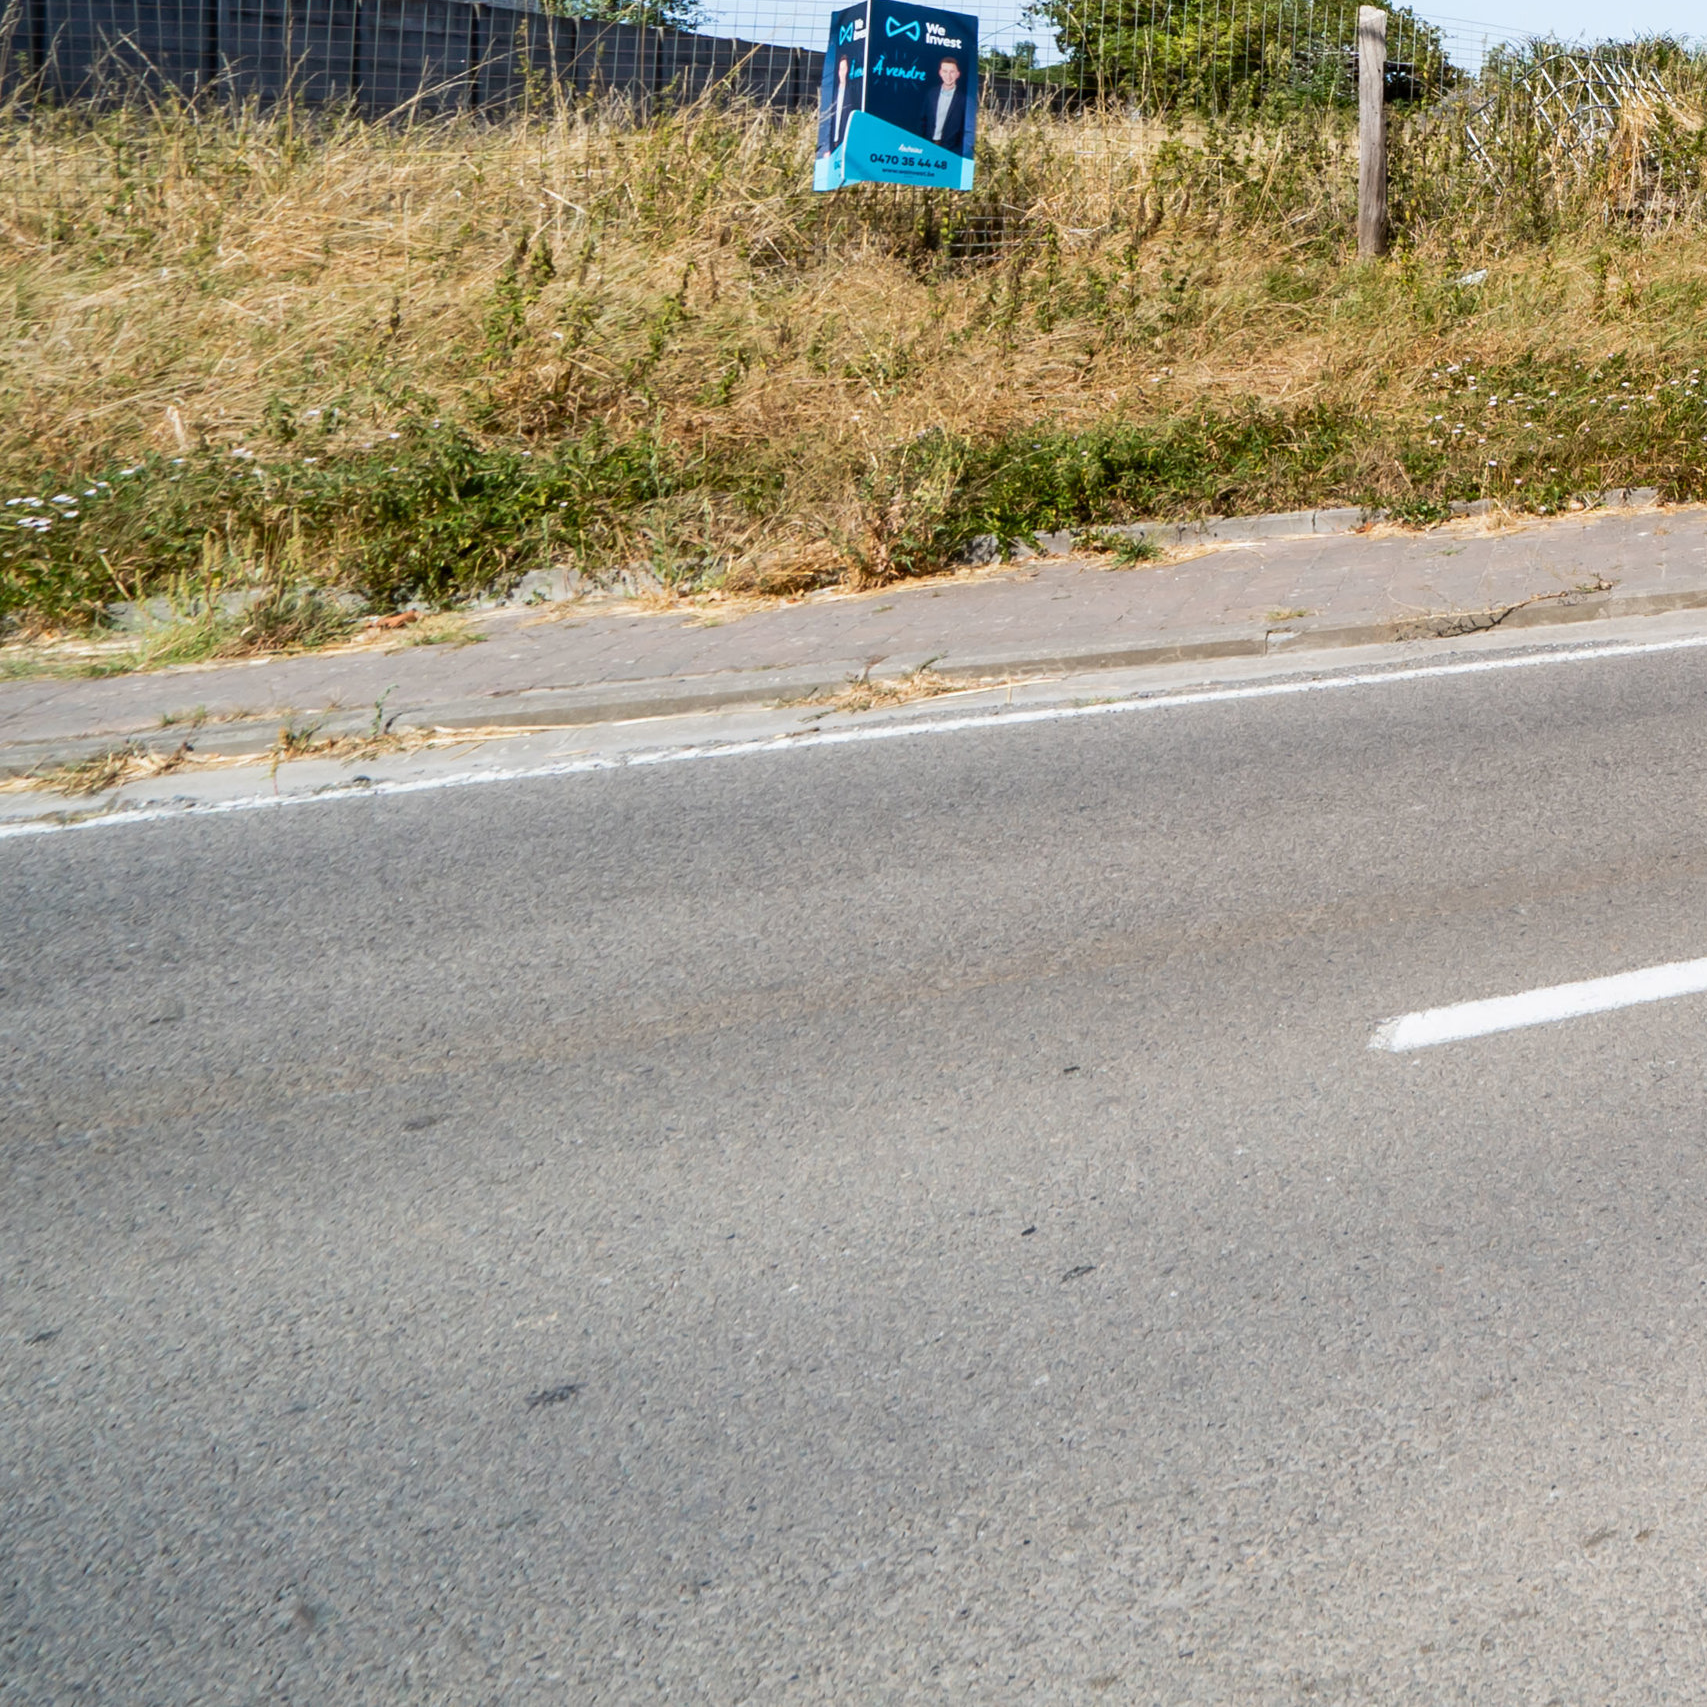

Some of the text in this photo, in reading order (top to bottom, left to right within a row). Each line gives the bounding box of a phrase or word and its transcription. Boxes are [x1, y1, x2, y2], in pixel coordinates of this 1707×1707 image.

[925, 22, 946, 36] We
[925, 33, 963, 49] Invest
[872, 54, 886, 76] À
[886, 65, 926, 81] vendre
[870, 153, 947, 170] 0470 35 44 48
